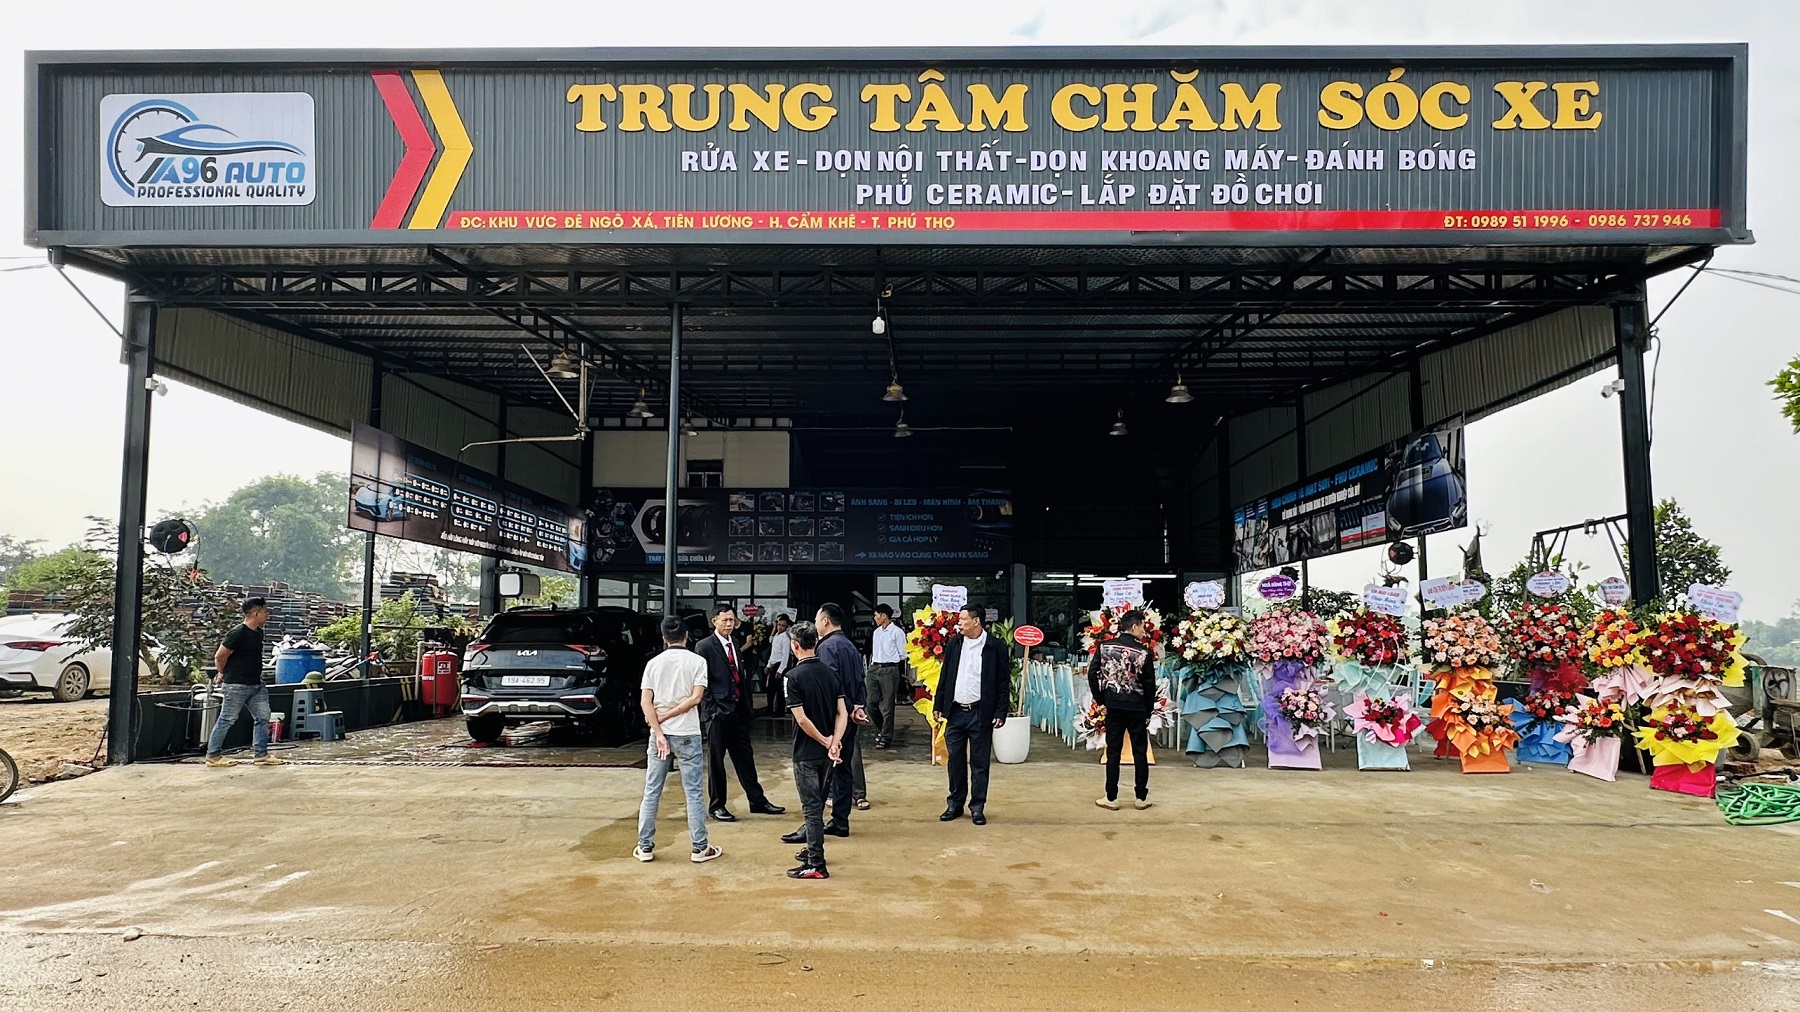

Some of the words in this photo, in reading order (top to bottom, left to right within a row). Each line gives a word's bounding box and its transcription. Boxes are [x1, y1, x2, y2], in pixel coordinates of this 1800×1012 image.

[567, 83, 837, 132] TRUNG
[861, 69, 1029, 132] TÂM
[1051, 69, 1281, 132] CHĂM
[1318, 67, 1470, 131] SÓC
[1493, 81, 1603, 130] XE
[681, 142, 738, 172] RỬA
[752, 150, 790, 172] XE
[815, 149, 871, 177] DỌN
[877, 143, 923, 177] NỘI
[1101, 149, 1210, 171] KHOANG
[1304, 140, 1384, 170] ĐÁNH
[1398, 141, 1476, 170] BÓNG
[225, 162, 306, 184] AUTO
[137, 185, 241, 198] PROFESSIONAL
[246, 184, 306, 198] QUALITY
[856, 178, 913, 205] PHỦ
[1081, 173, 1136, 205] LẮP
[1147, 178, 1201, 210] ĐẶT
[1210, 172, 1249, 206] ĐỒ
[1255, 180, 1322, 205] CHƠI
[459, 215, 486, 229] ĐC:
[488, 215, 519, 229] KHU
[564, 213, 583, 229] ĐÊ
[589, 213, 624, 229] NGÔ
[631, 211, 658, 230] XÁ,
[664, 213, 695, 229] TIÊN
[702, 214, 754, 229] LƯƠNG
[769, 216, 783, 229] H.
[828, 212, 856, 229] KHÊ
[871, 216, 881, 229] T.
[887, 212, 917, 229] PHÚ
[924, 216, 956, 231] THỌ
[1443, 215, 1468, 228] ĐT:
[1471, 215, 1508, 228] 0989
[1512, 215, 1527, 228] 51
[1533, 215, 1569, 228] 1996
[1588, 215, 1627, 227] 0986
[1633, 215, 1659, 227] 737
[1663, 215, 1692, 227] 946
[1348, 459, 1378, 480] CERAMIC
